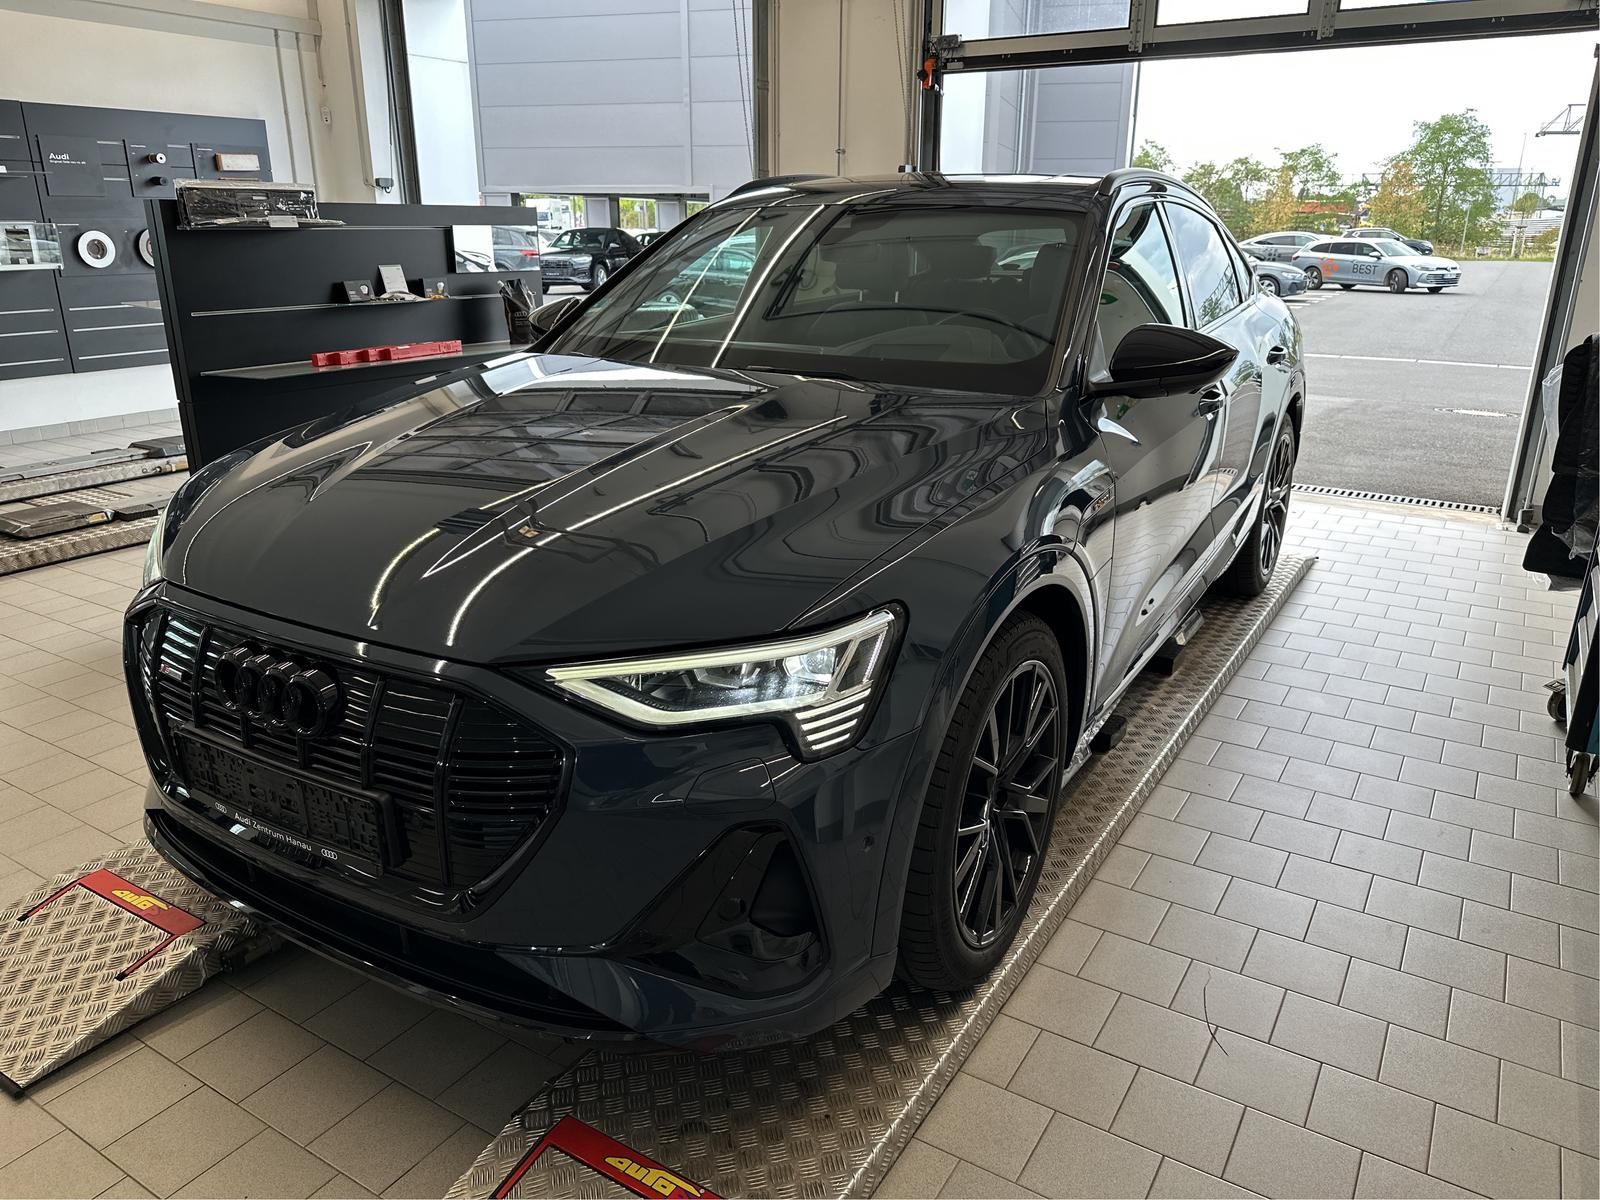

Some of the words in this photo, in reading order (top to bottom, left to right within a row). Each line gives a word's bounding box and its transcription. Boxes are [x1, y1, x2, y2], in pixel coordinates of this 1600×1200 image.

[49, 152, 70, 160] Audi
[1352, 263, 1379, 275] BEST
[234, 812, 251, 826] Audi
[252, 820, 285, 841] Zentrum
[285, 834, 312, 851] Hanau
